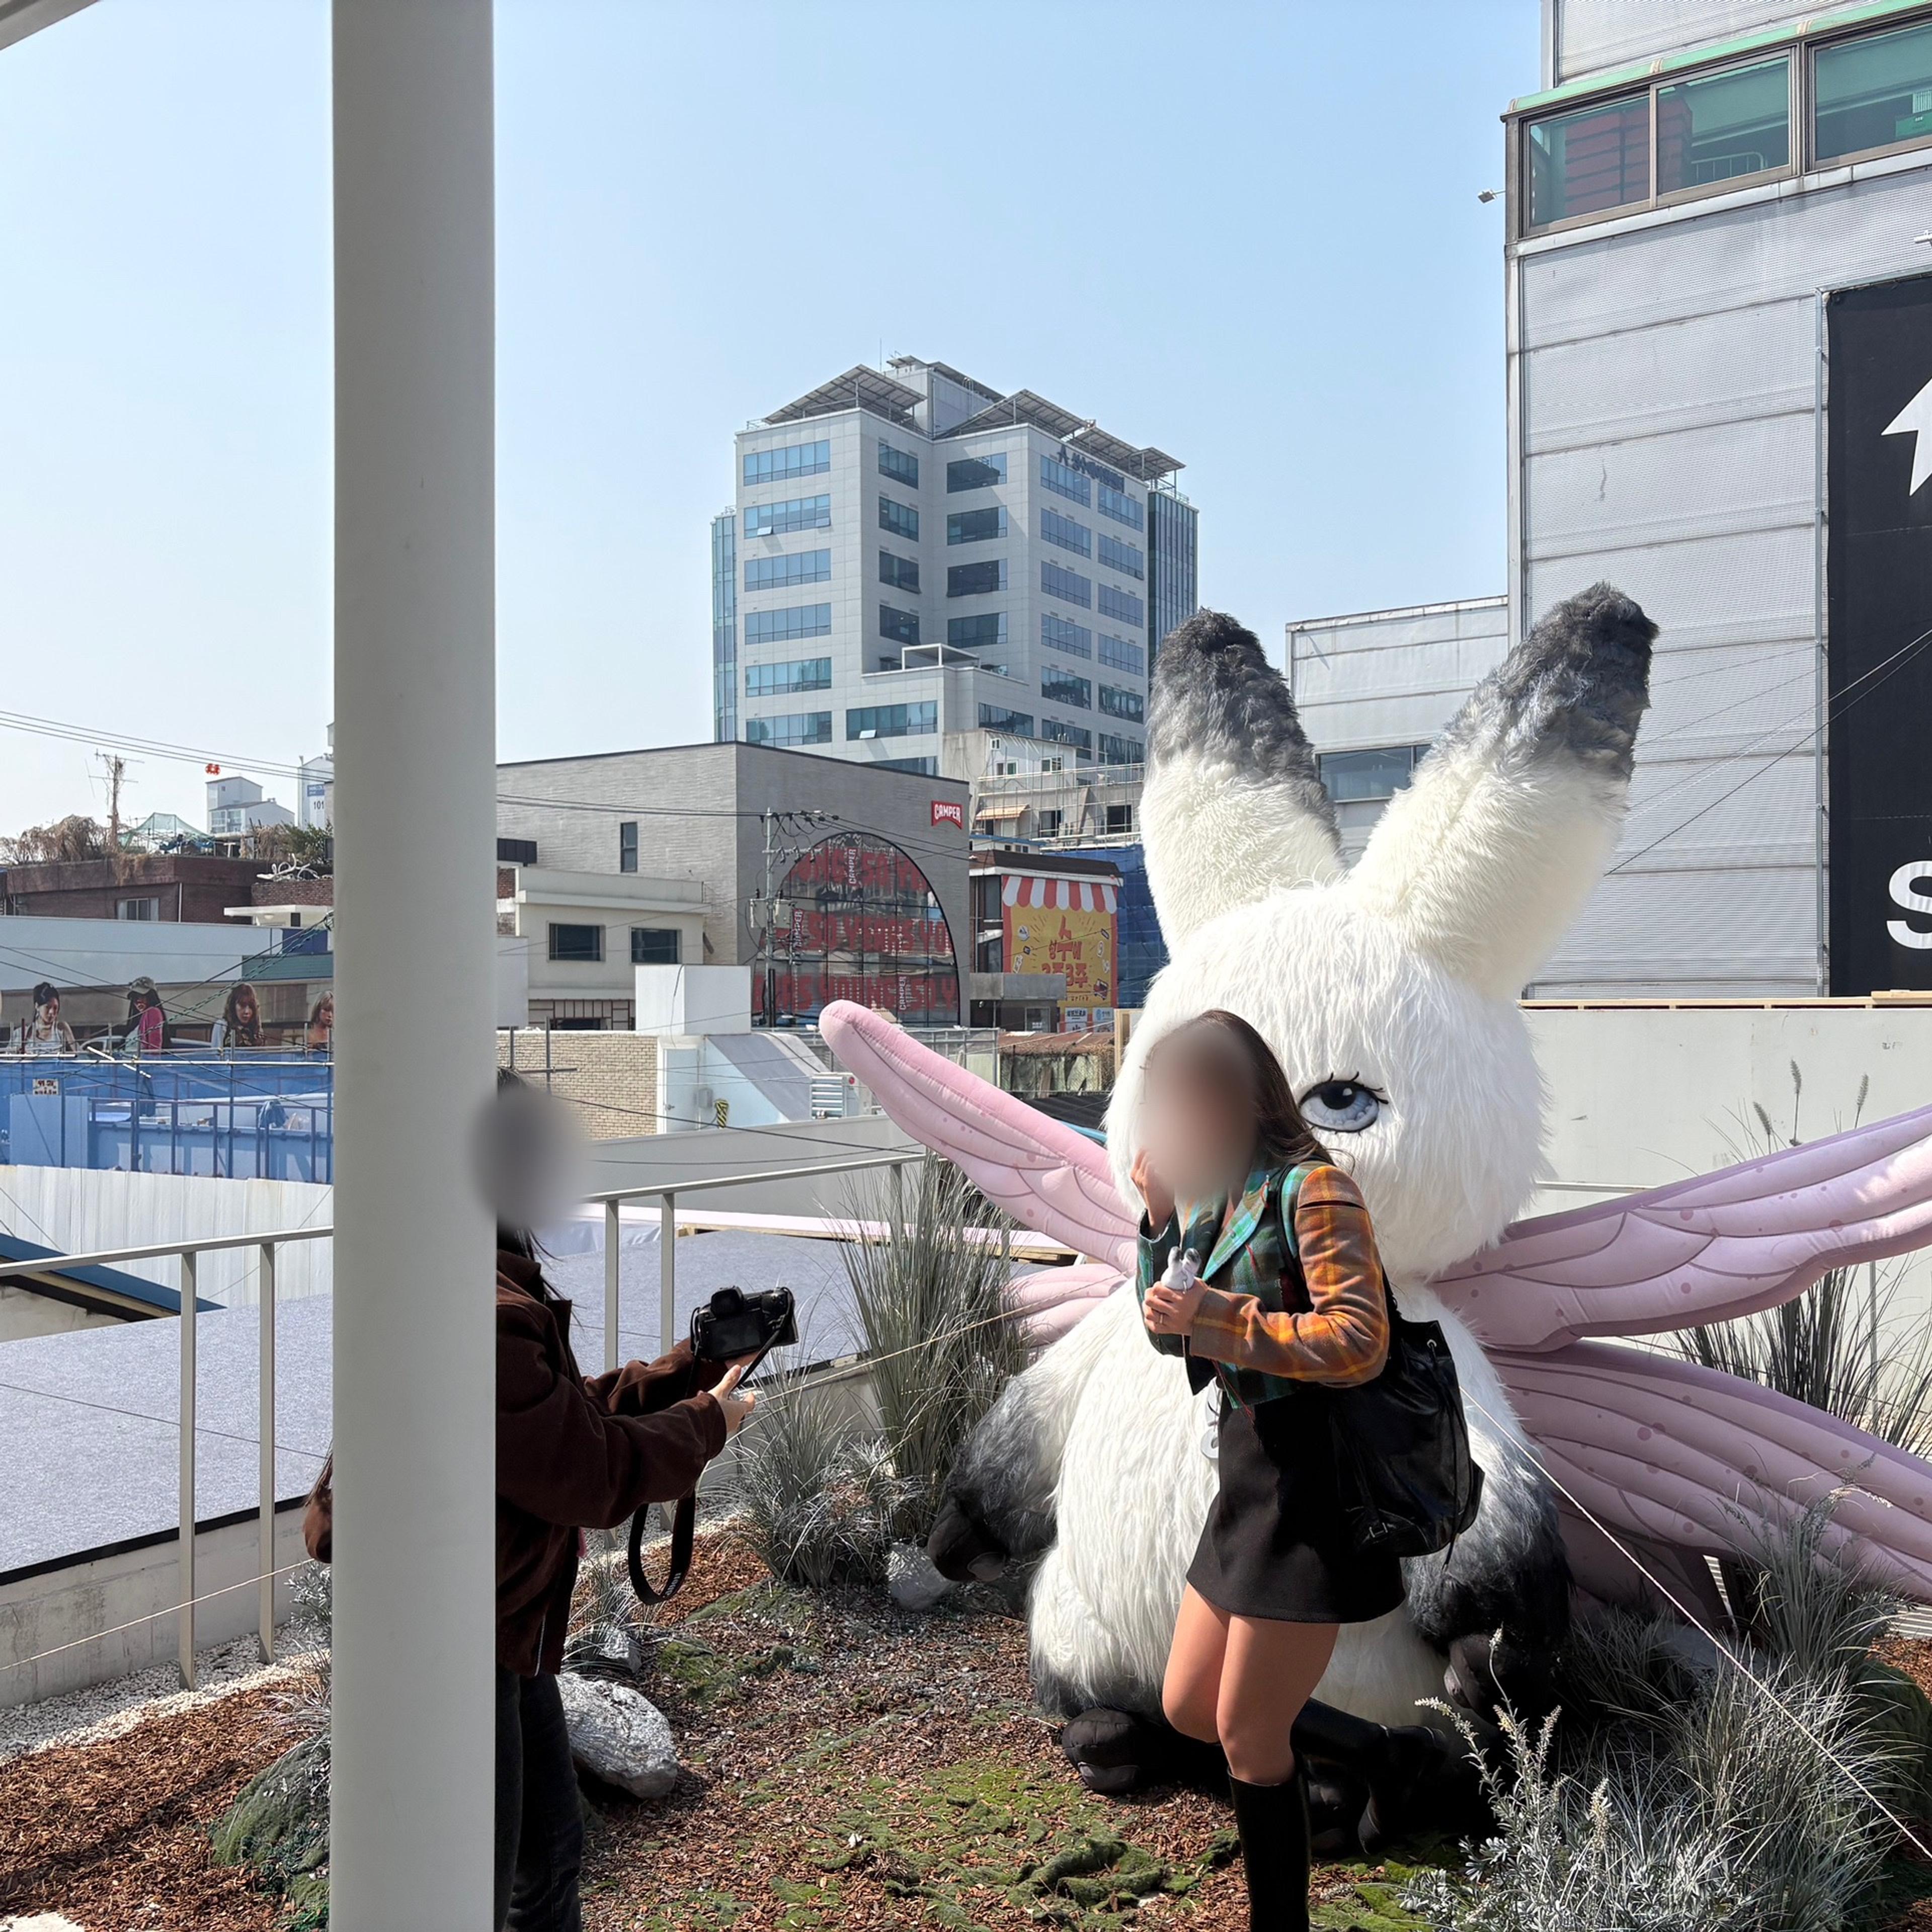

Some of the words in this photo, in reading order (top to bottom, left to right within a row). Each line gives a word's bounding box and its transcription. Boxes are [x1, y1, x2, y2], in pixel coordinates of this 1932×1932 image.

[314, 801, 325, 810] 101
[935, 804, 960, 823] CAMPER
[848, 849, 857, 884] CAMPER
